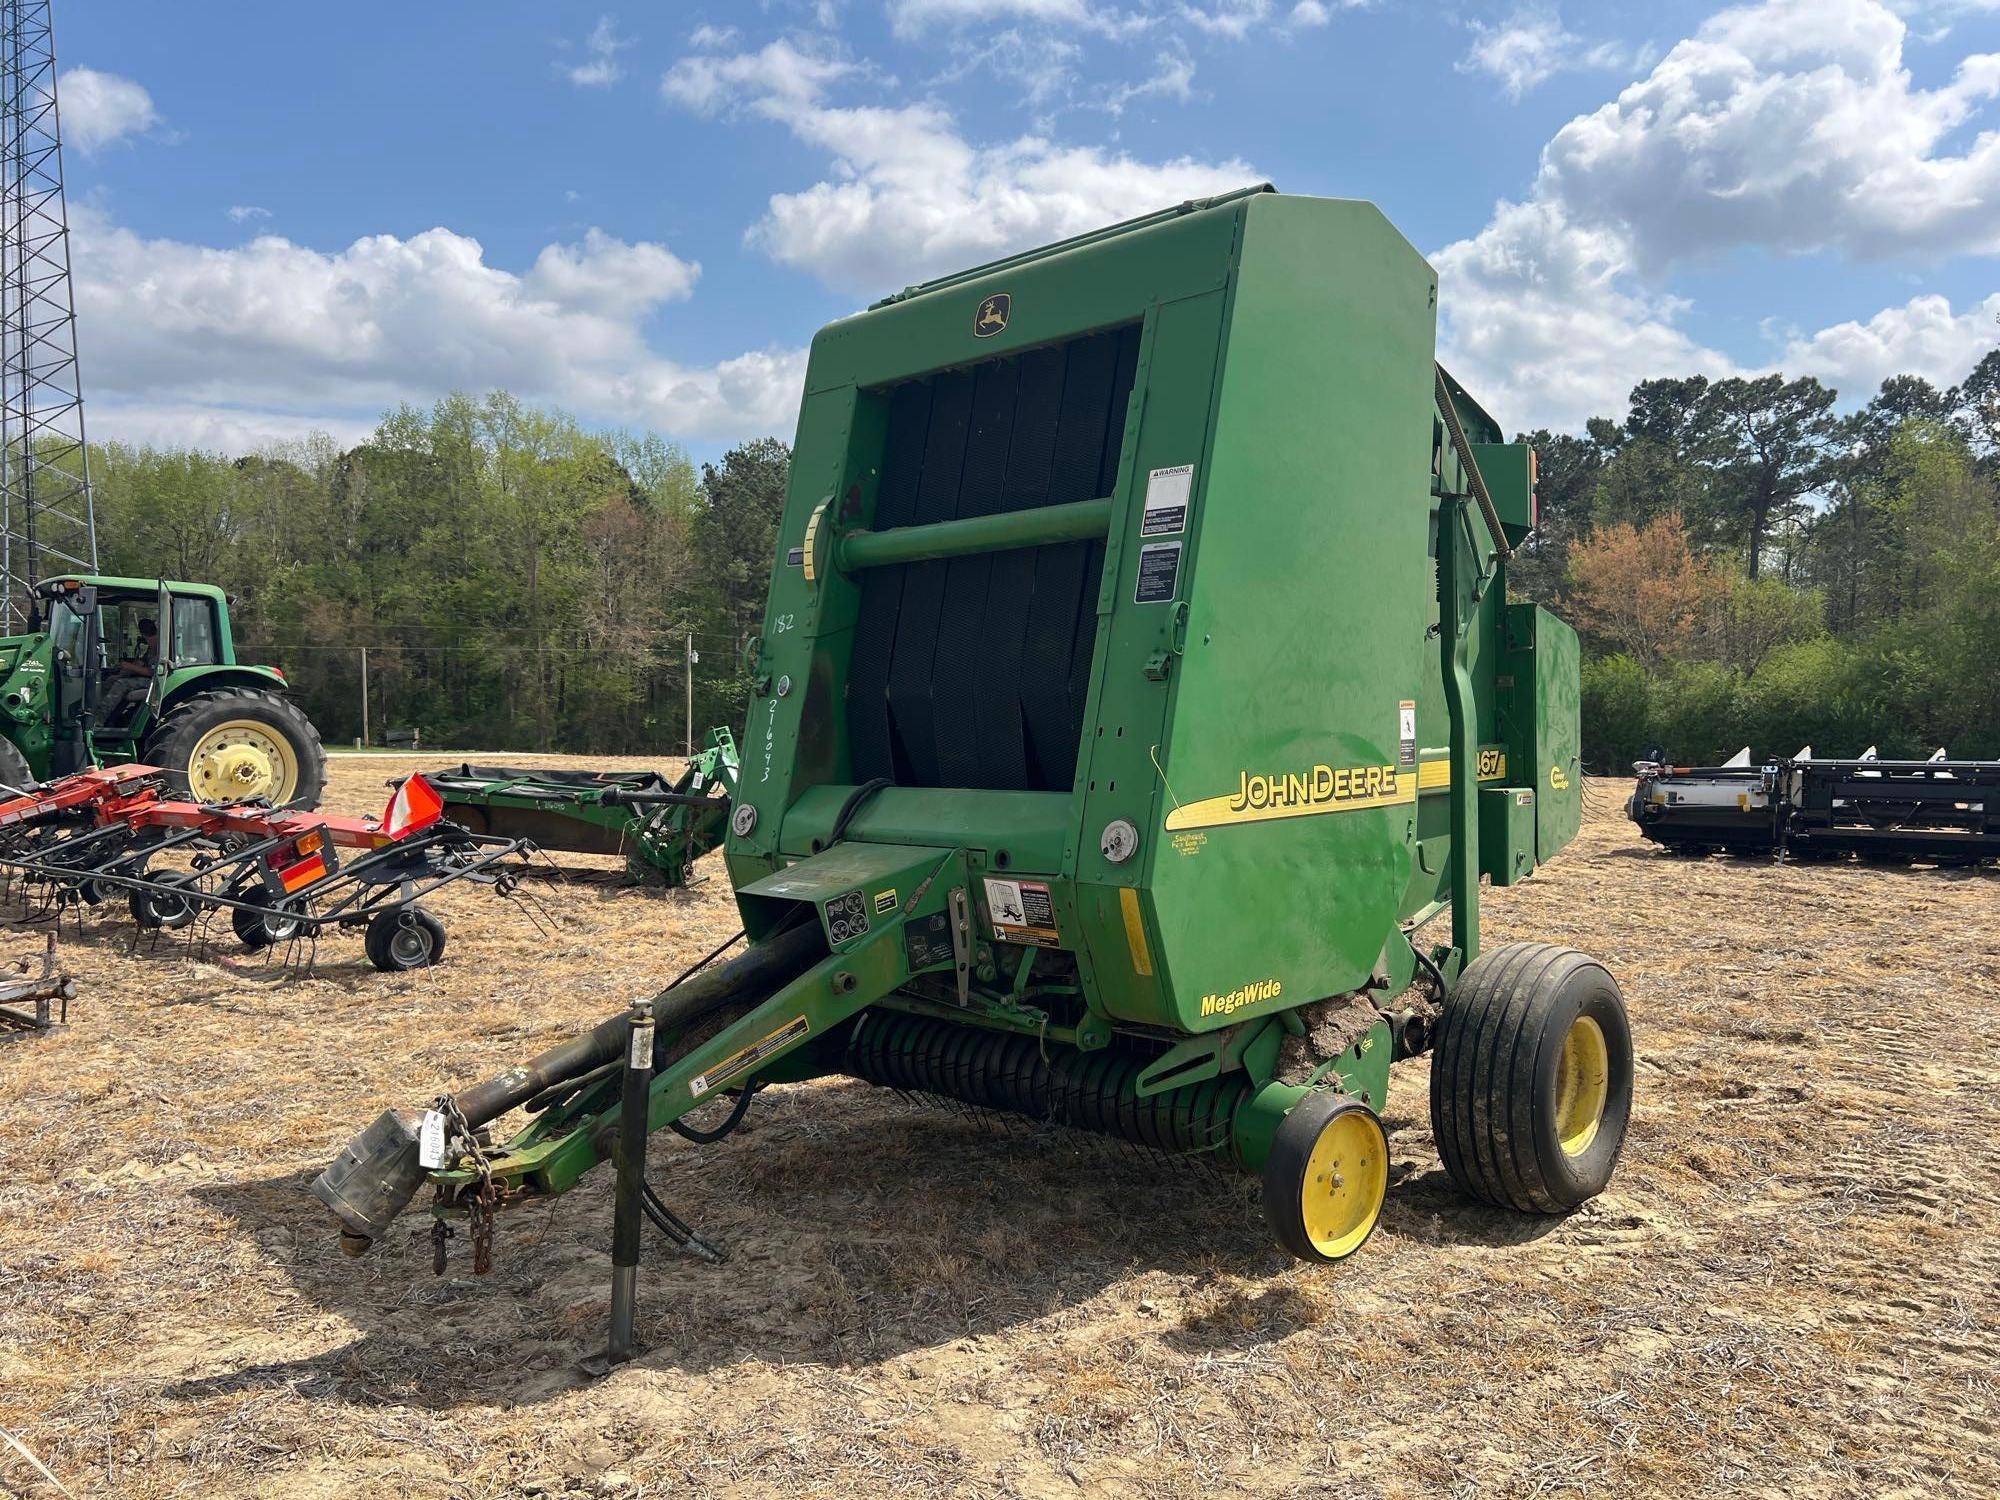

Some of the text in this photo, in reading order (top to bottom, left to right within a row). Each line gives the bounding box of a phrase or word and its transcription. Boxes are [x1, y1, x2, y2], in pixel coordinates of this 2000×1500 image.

[1159, 467, 1190, 476] WARNING
[772, 613, 795, 634] 182
[1230, 763, 1398, 812] JOHN DEERE
[1200, 978, 1282, 1018] MegaWide
